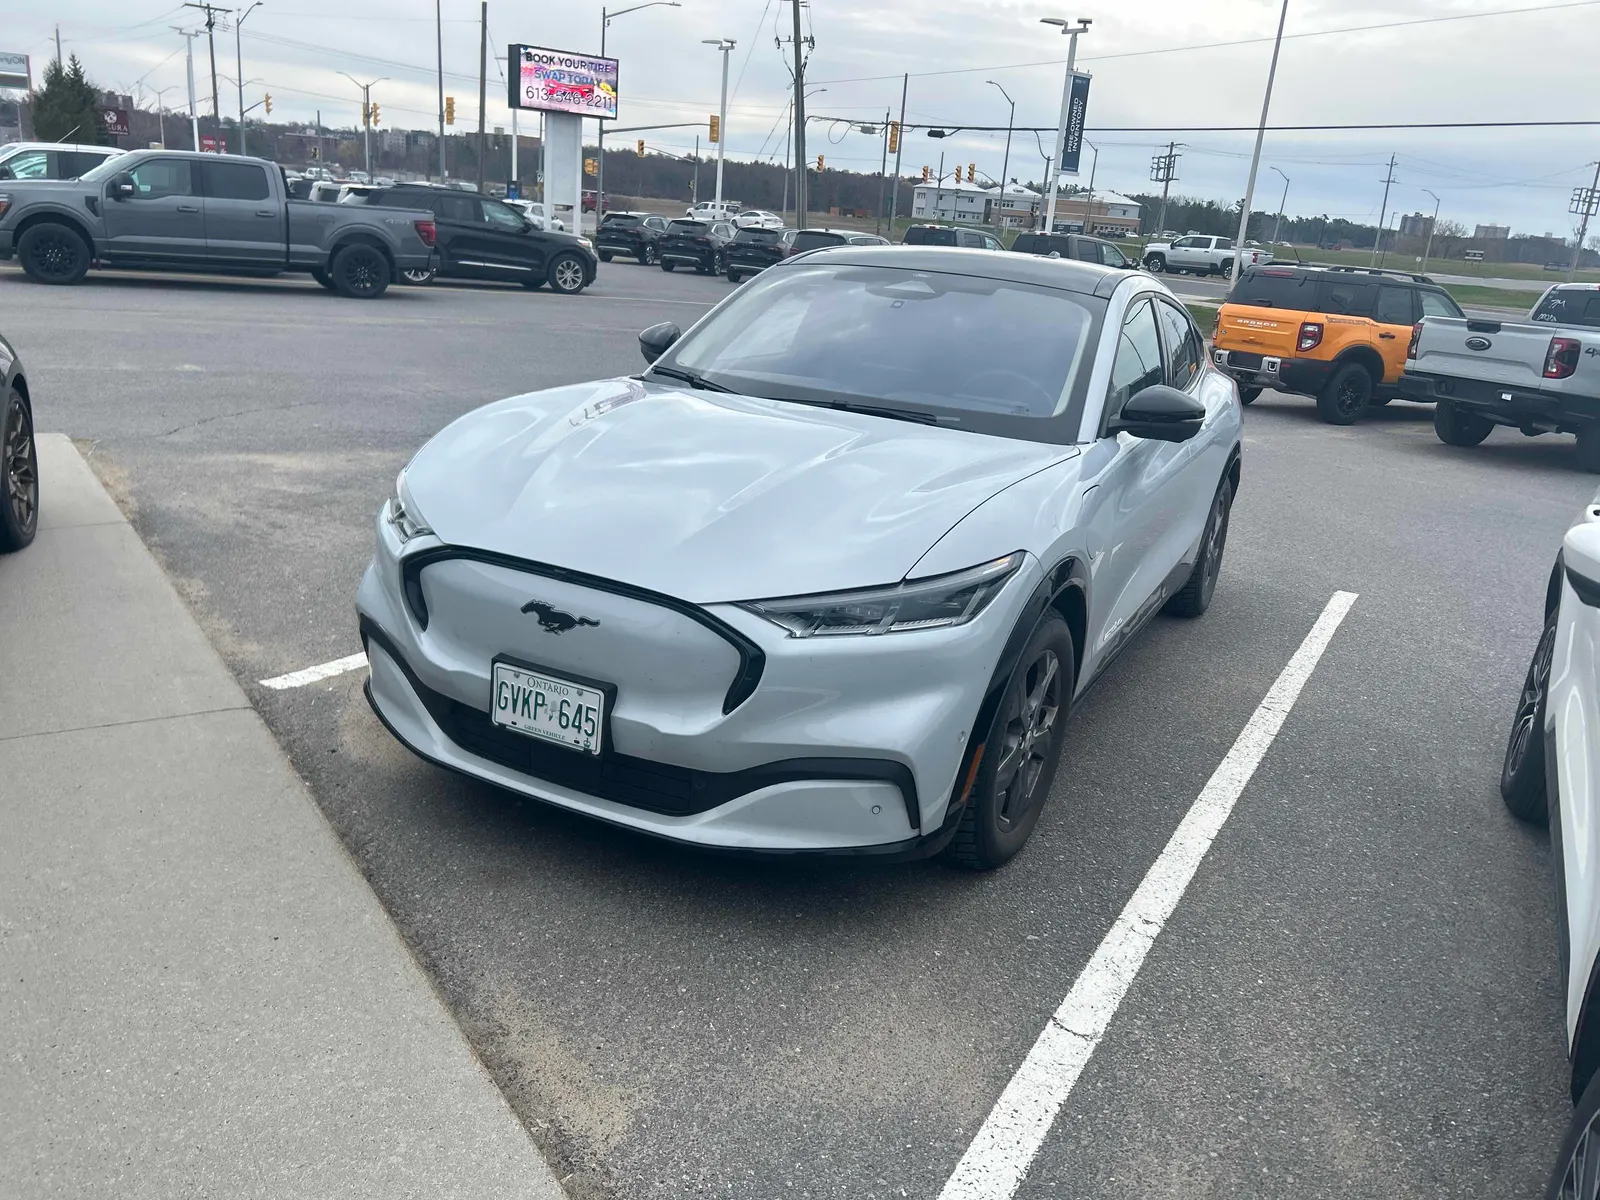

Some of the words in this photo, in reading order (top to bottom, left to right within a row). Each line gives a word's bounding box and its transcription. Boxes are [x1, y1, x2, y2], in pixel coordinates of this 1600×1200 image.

[525, 52, 556, 66] BOOK
[557, 58, 588, 70] YOUR
[588, 62, 612, 73] TIRE
[534, 69, 566, 82] SWAP
[567, 74, 603, 86] TODAY
[526, 85, 612, 109] 613-546-2211
[1067, 97, 1080, 153] PRE-OWNED
[1072, 100, 1084, 152] INVENTORY
[1237, 318, 1278, 328] BRONCO
[527, 676, 569, 696] ONTARIO
[497, 680, 546, 721] GVKP
[558, 697, 597, 737] 645
[524, 724, 542, 733] GREEN
[542, 729, 566, 740] VEHICLE
